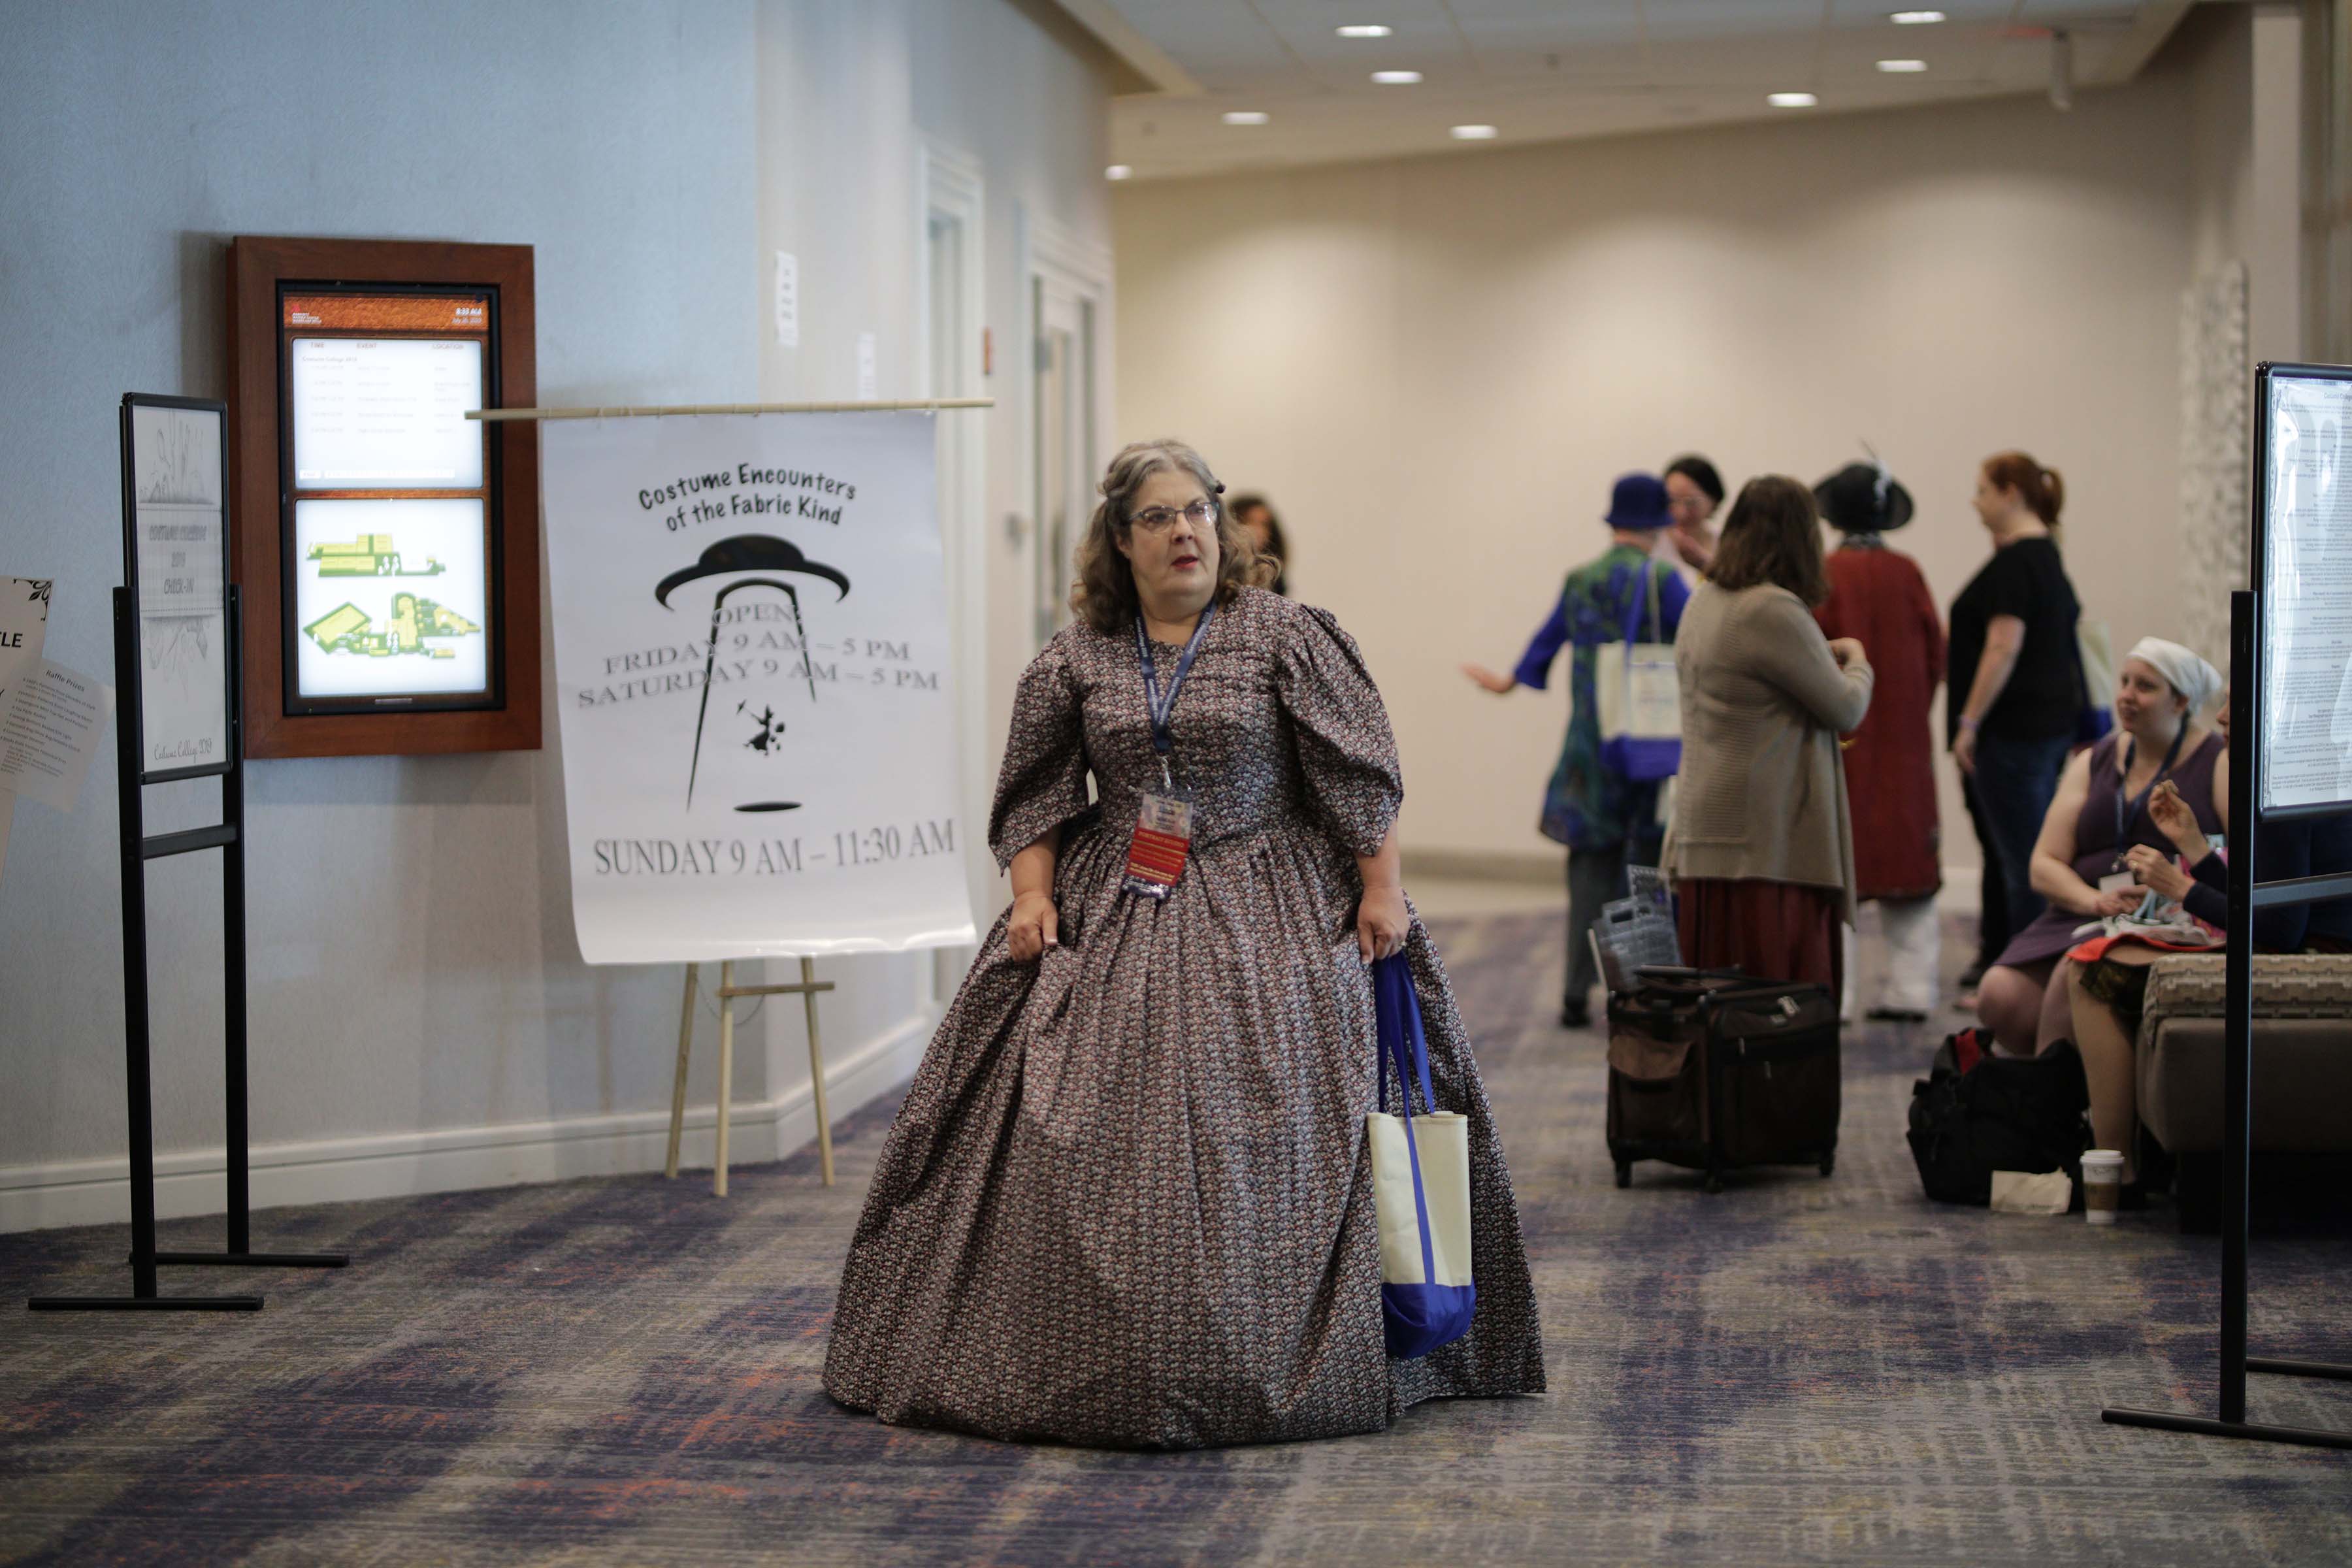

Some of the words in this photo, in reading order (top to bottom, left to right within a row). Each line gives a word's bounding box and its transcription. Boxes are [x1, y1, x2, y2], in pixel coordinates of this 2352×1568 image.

[638, 470, 732, 510] Costume
[738, 463, 856, 500] Encounters
[666, 505, 686, 532] of
[691, 499, 726, 523] the
[731, 493, 791, 515] Fabric
[798, 495, 843, 525] Kind
[0, 631, 23, 648] LE
[603, 637, 723, 675] FRIDAY
[733, 633, 749, 650] 9
[757, 630, 808, 651] AM
[842, 638, 857, 655] 5
[866, 639, 910, 660] PM
[46, 670, 65, 682] Raffle
[66, 678, 84, 692] Prizes
[578, 659, 754, 709] SATURDAY
[763, 659, 779, 676] 9
[788, 661, 838, 682] AM
[872, 668, 885, 685] 5
[895, 669, 939, 690] PM
[593, 838, 723, 875] SUNDAY
[730, 838, 745, 875] 9
[755, 838, 803, 874] AM
[834, 826, 901, 867] 11:30
[907, 818, 956, 857] AM
